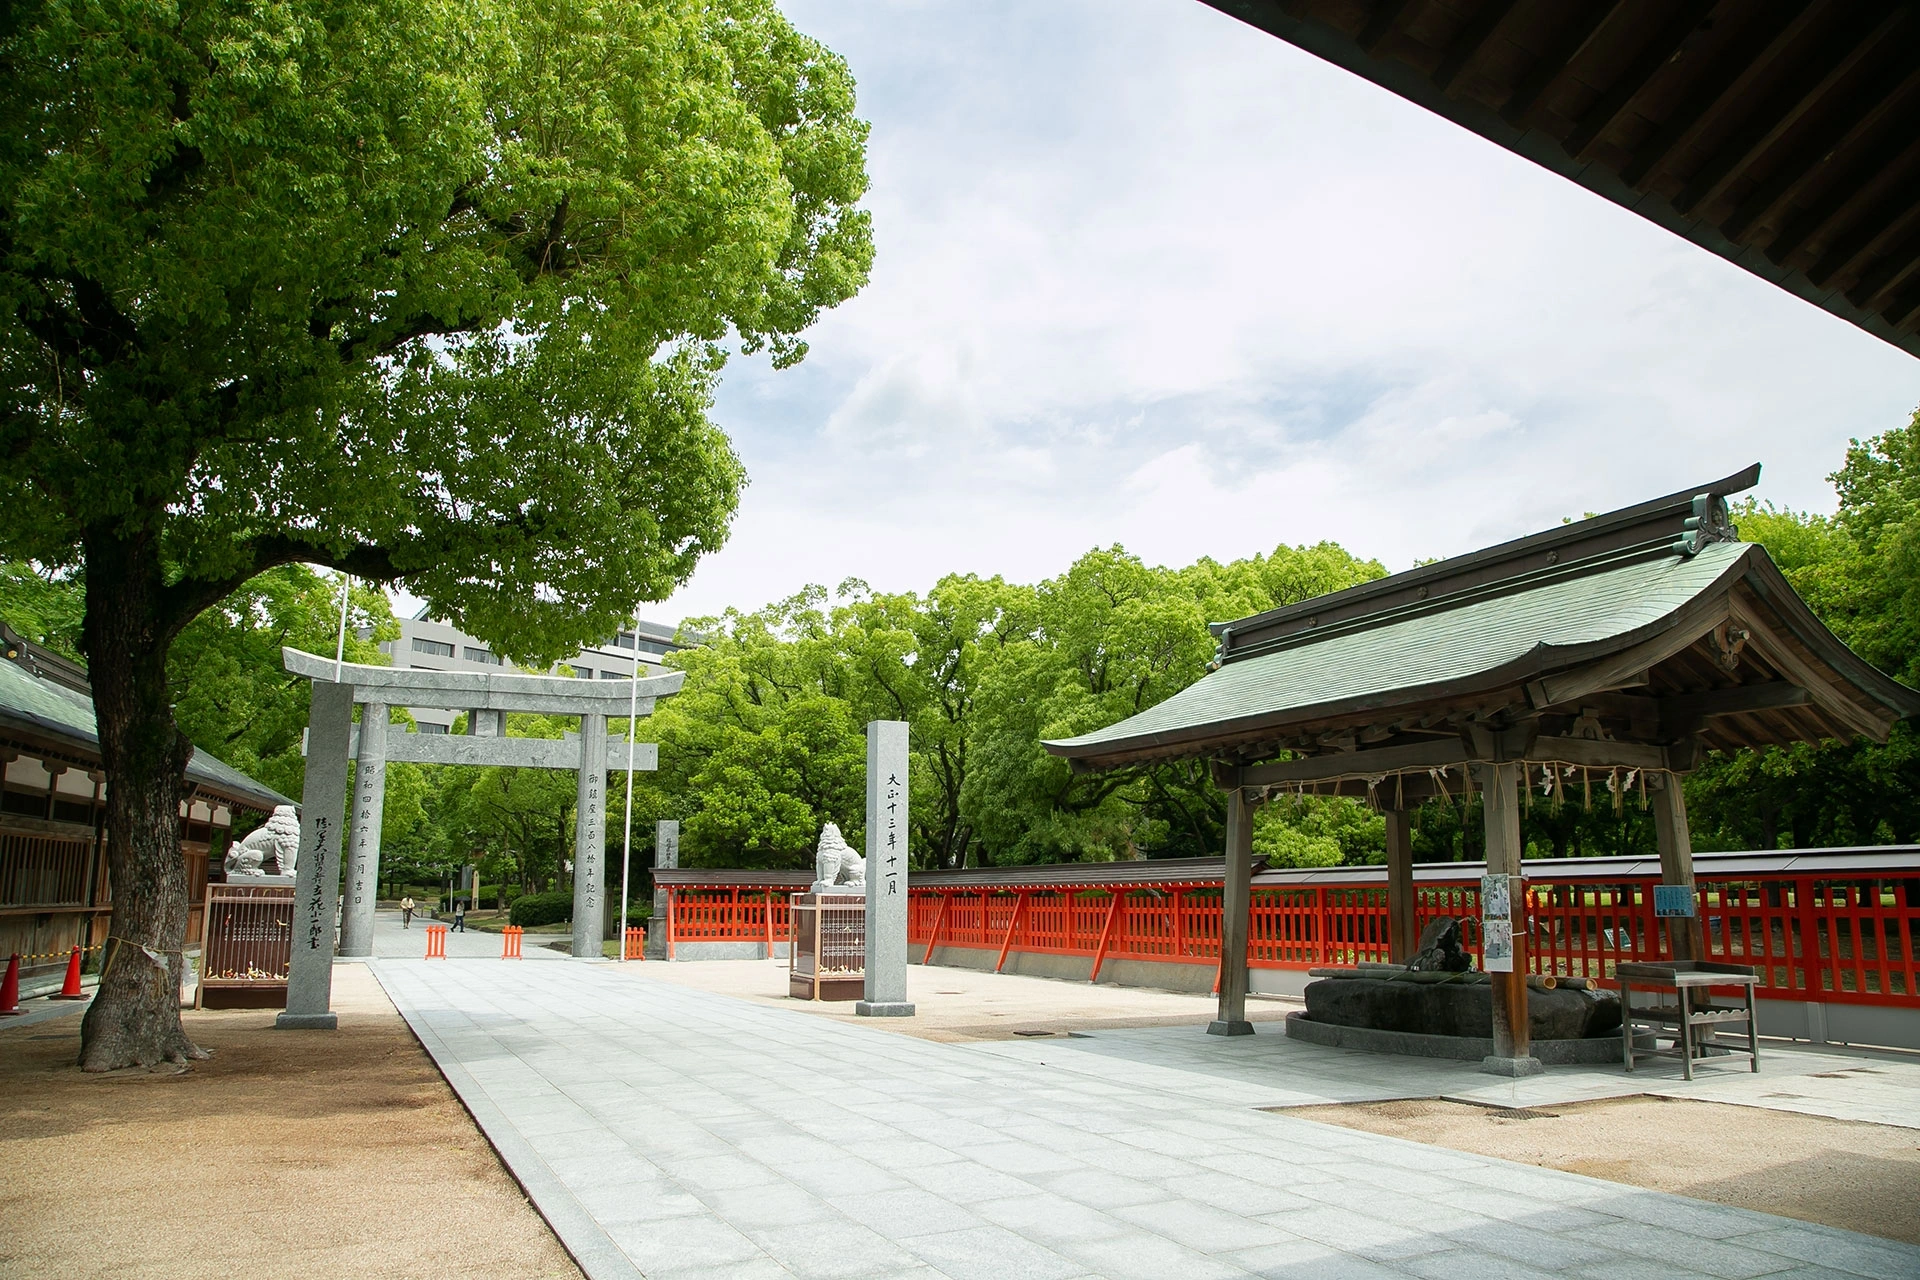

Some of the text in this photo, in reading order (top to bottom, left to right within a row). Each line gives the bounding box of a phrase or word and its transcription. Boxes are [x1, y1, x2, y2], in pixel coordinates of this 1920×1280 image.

[885, 773, 901, 896] 大正十三年十一月
